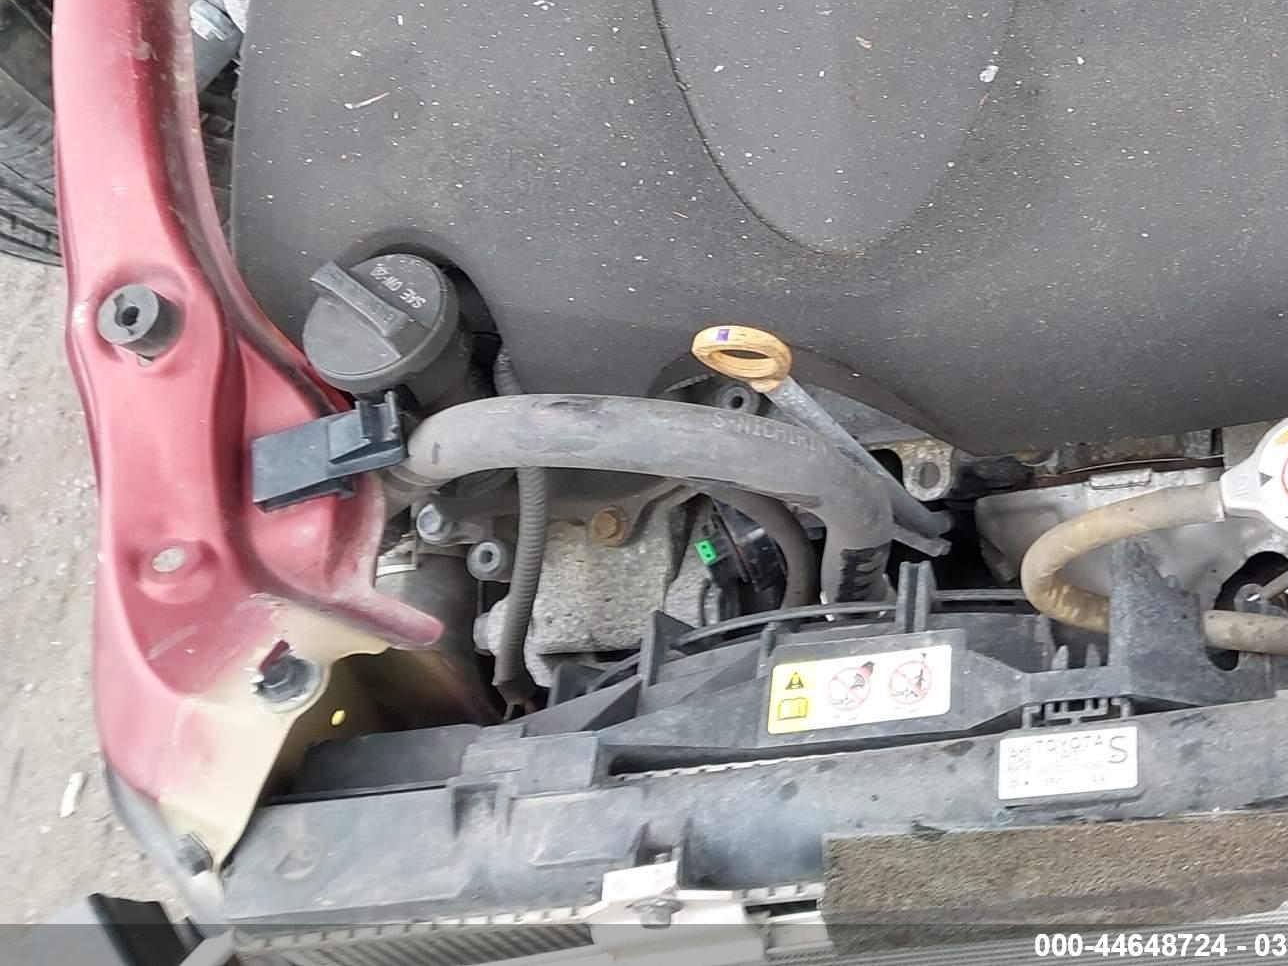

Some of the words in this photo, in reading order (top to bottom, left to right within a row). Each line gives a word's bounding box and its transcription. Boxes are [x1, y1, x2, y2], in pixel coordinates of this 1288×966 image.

[399, 287, 427, 309] SAE
[1035, 734, 1104, 753] TOYOTA
[1108, 735, 1129, 765] S
